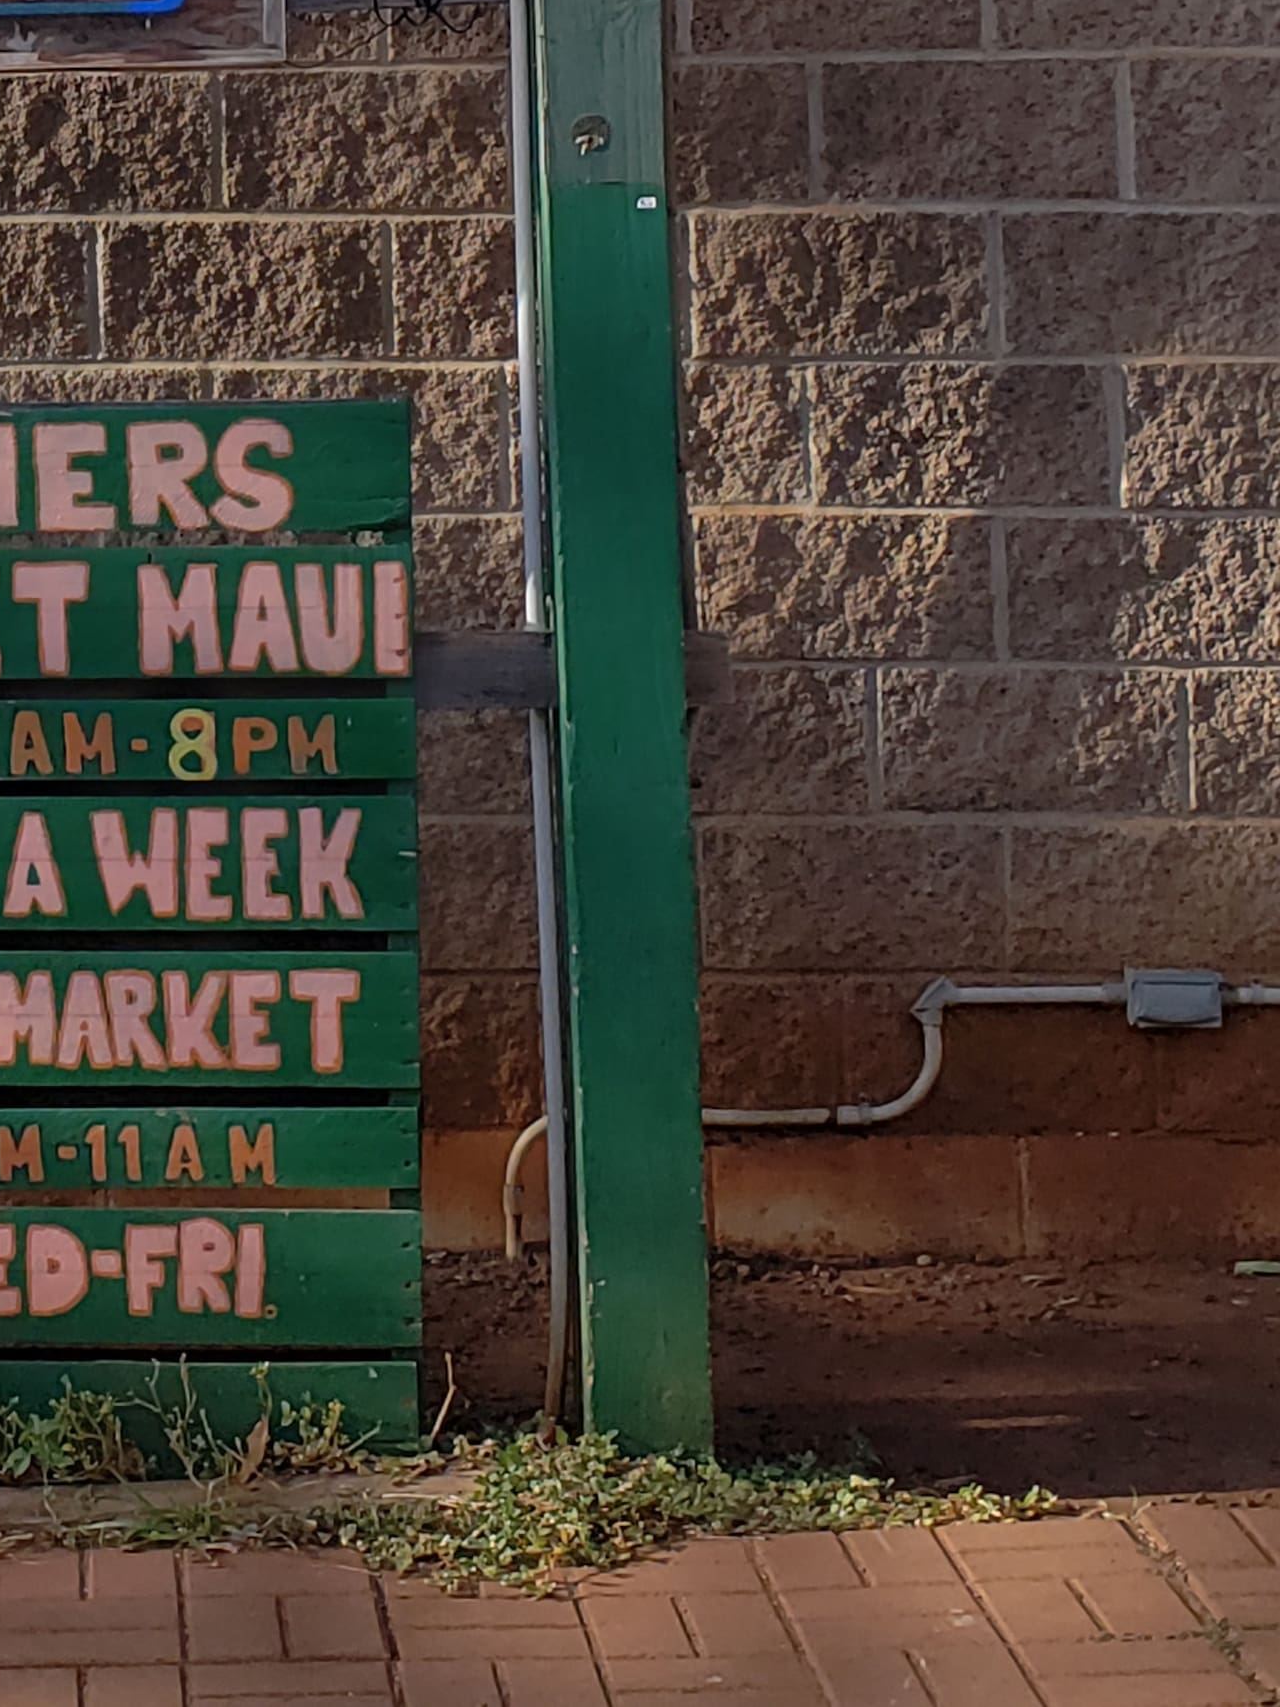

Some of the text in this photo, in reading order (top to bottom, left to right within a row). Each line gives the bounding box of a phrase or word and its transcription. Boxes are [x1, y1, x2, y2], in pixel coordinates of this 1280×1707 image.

[137, 561, 413, 677] MAUI
[2, 810, 67, 918] A
[89, 806, 365, 921] WEEK
